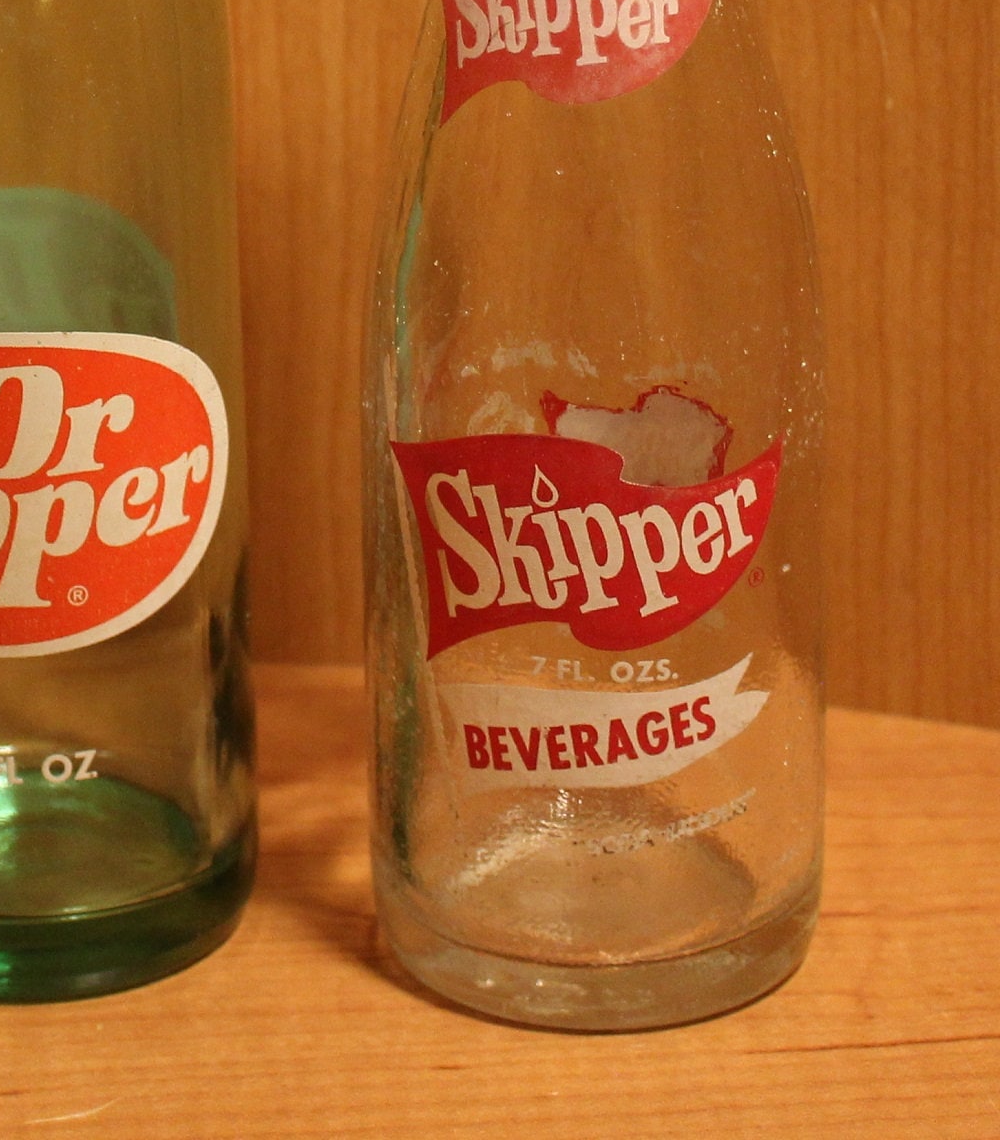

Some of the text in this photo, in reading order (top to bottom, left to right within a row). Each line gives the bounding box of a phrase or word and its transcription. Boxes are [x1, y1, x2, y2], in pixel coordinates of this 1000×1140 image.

[424, 463, 758, 618] Skipper
[530, 655, 546, 675] 7
[609, 658, 679, 684] OZS.
[462, 695, 717, 772] BEVERAGES
[41, 748, 99, 783] OZ
